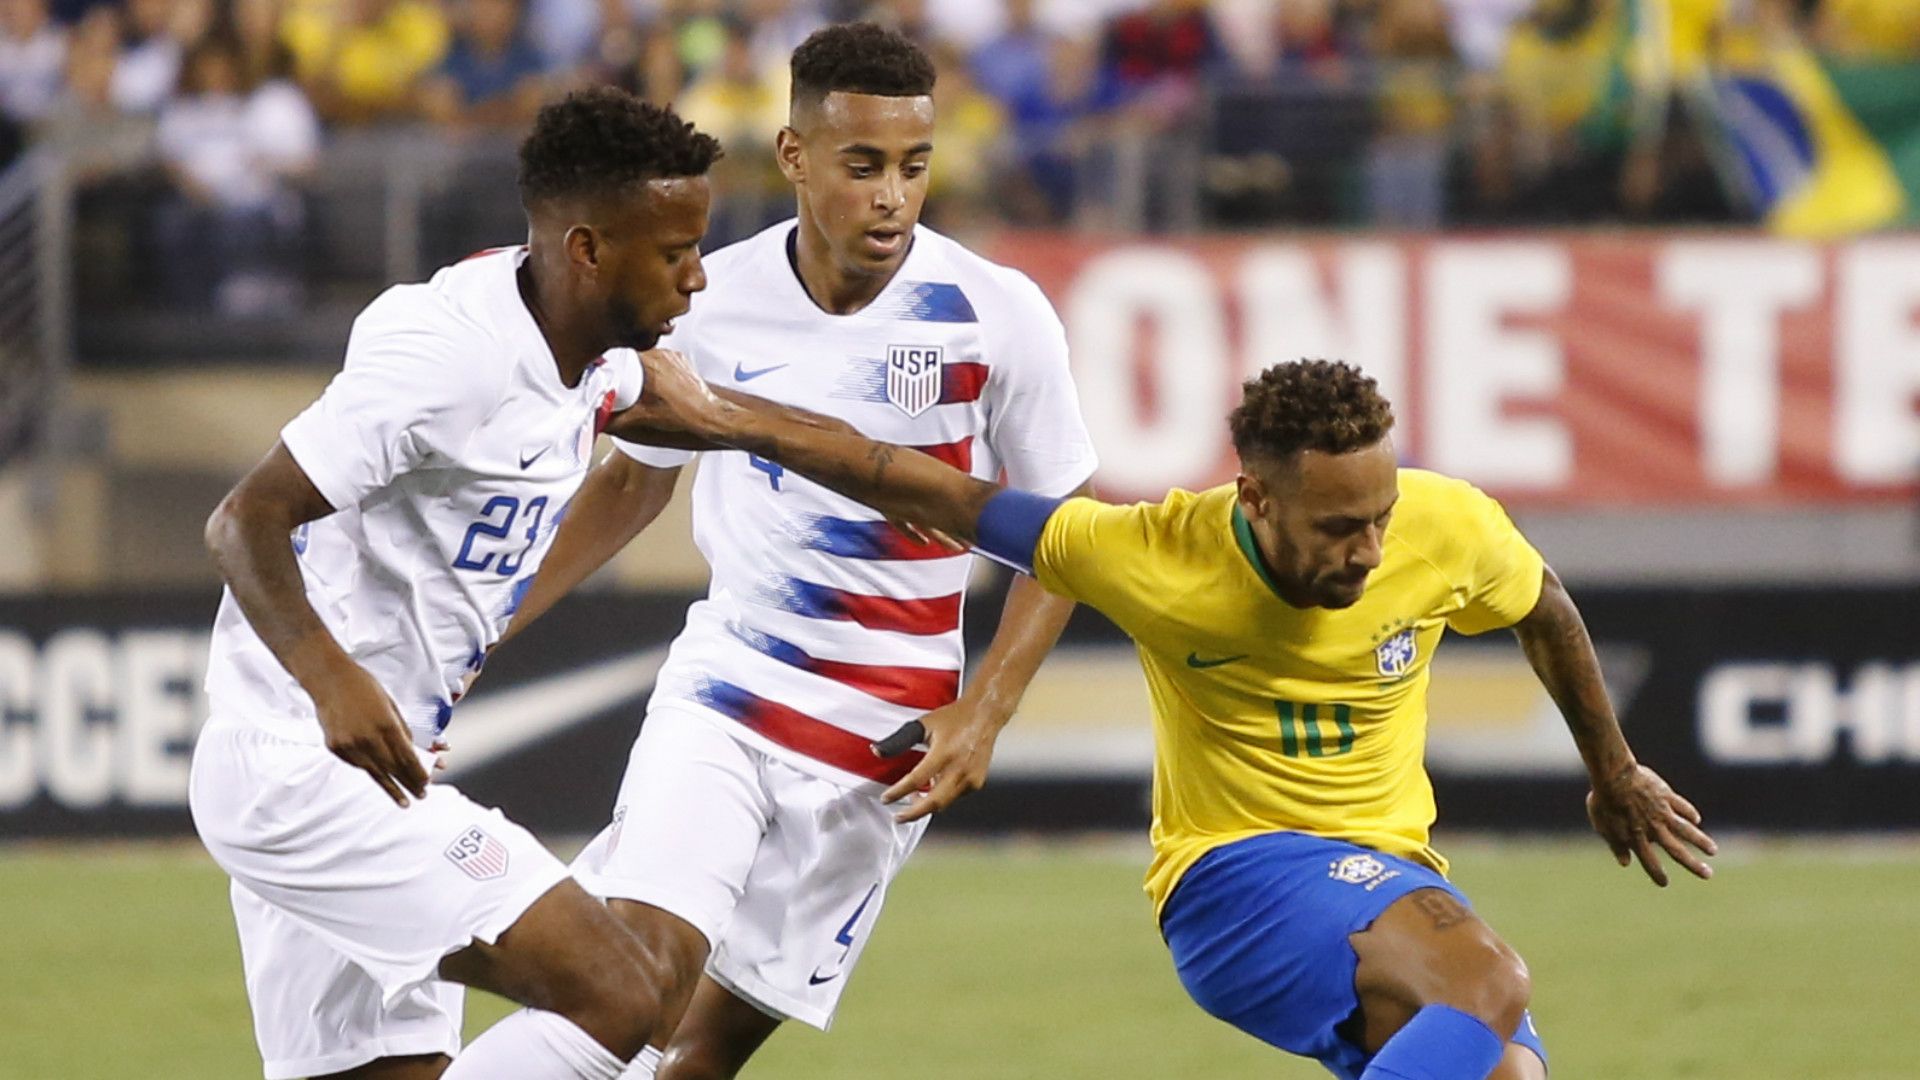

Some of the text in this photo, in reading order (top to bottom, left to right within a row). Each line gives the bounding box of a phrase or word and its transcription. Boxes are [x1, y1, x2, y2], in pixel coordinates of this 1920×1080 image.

[892, 350, 938, 375] USA
[452, 495, 548, 575] 23
[1274, 699, 1355, 759] 10
[1697, 660, 1920, 765] CH
[450, 829, 483, 860] USA
